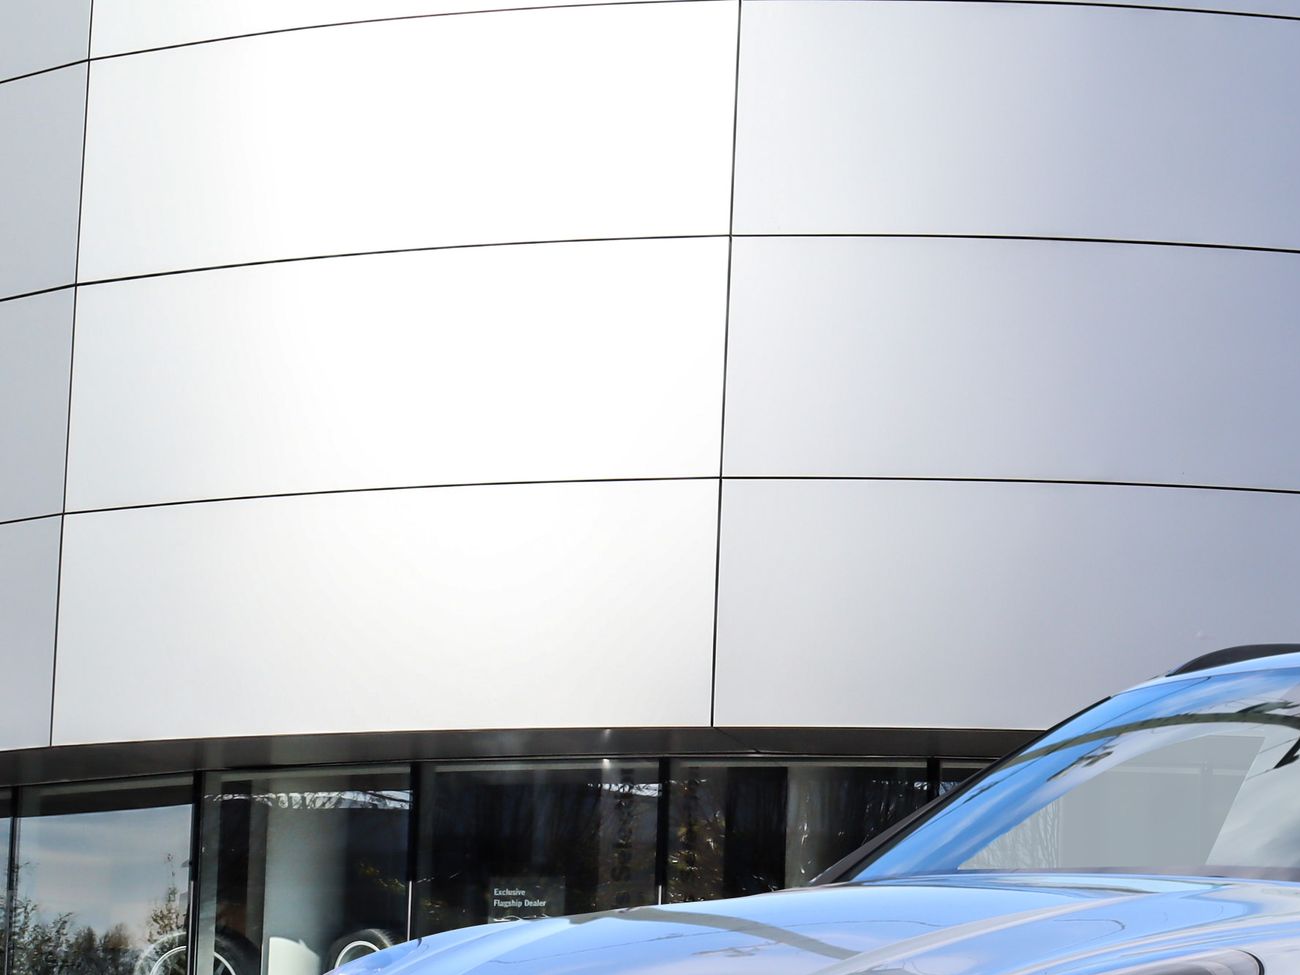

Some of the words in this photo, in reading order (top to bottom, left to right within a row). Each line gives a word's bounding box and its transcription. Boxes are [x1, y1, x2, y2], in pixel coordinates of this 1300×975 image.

[494, 888, 525, 896] Exclusive
[494, 899, 522, 908] Flagship
[524, 899, 546, 907] Dealer
